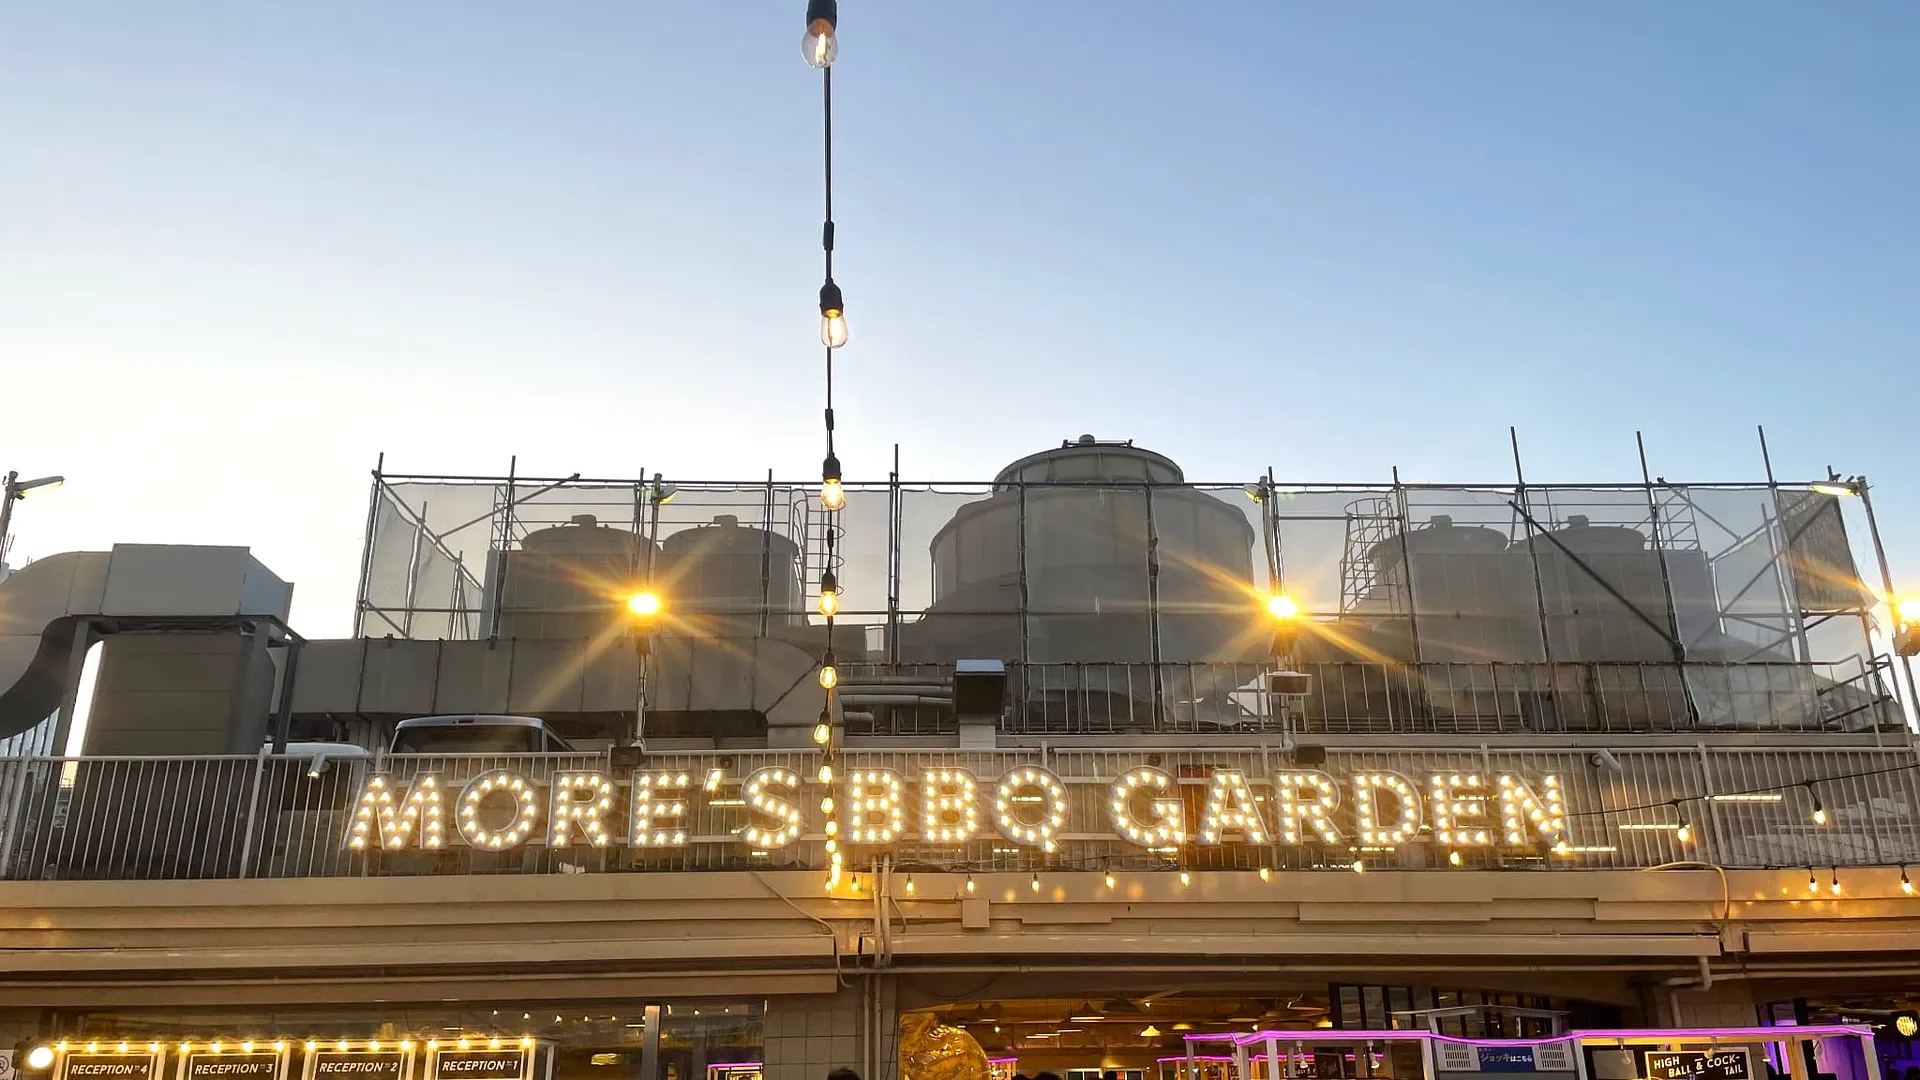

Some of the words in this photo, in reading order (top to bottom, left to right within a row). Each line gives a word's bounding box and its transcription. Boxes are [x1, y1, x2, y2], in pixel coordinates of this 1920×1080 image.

[342, 766, 806, 851] MORE'S
[846, 764, 1072, 856] BBQ
[1110, 765, 1573, 848] GARDEN
[442, 1060, 506, 1072] RECEPTION
[1653, 1056, 1680, 1070] HIGH
[1706, 1054, 1740, 1068] COCK-
[70, 1064, 134, 1075] RECEPTION
[195, 1063, 259, 1075] RECEPTION
[320, 1062, 384, 1073] RECEPTION
[1668, 1064, 1691, 1078] BALL
[1724, 1064, 1743, 1076] TAIL
